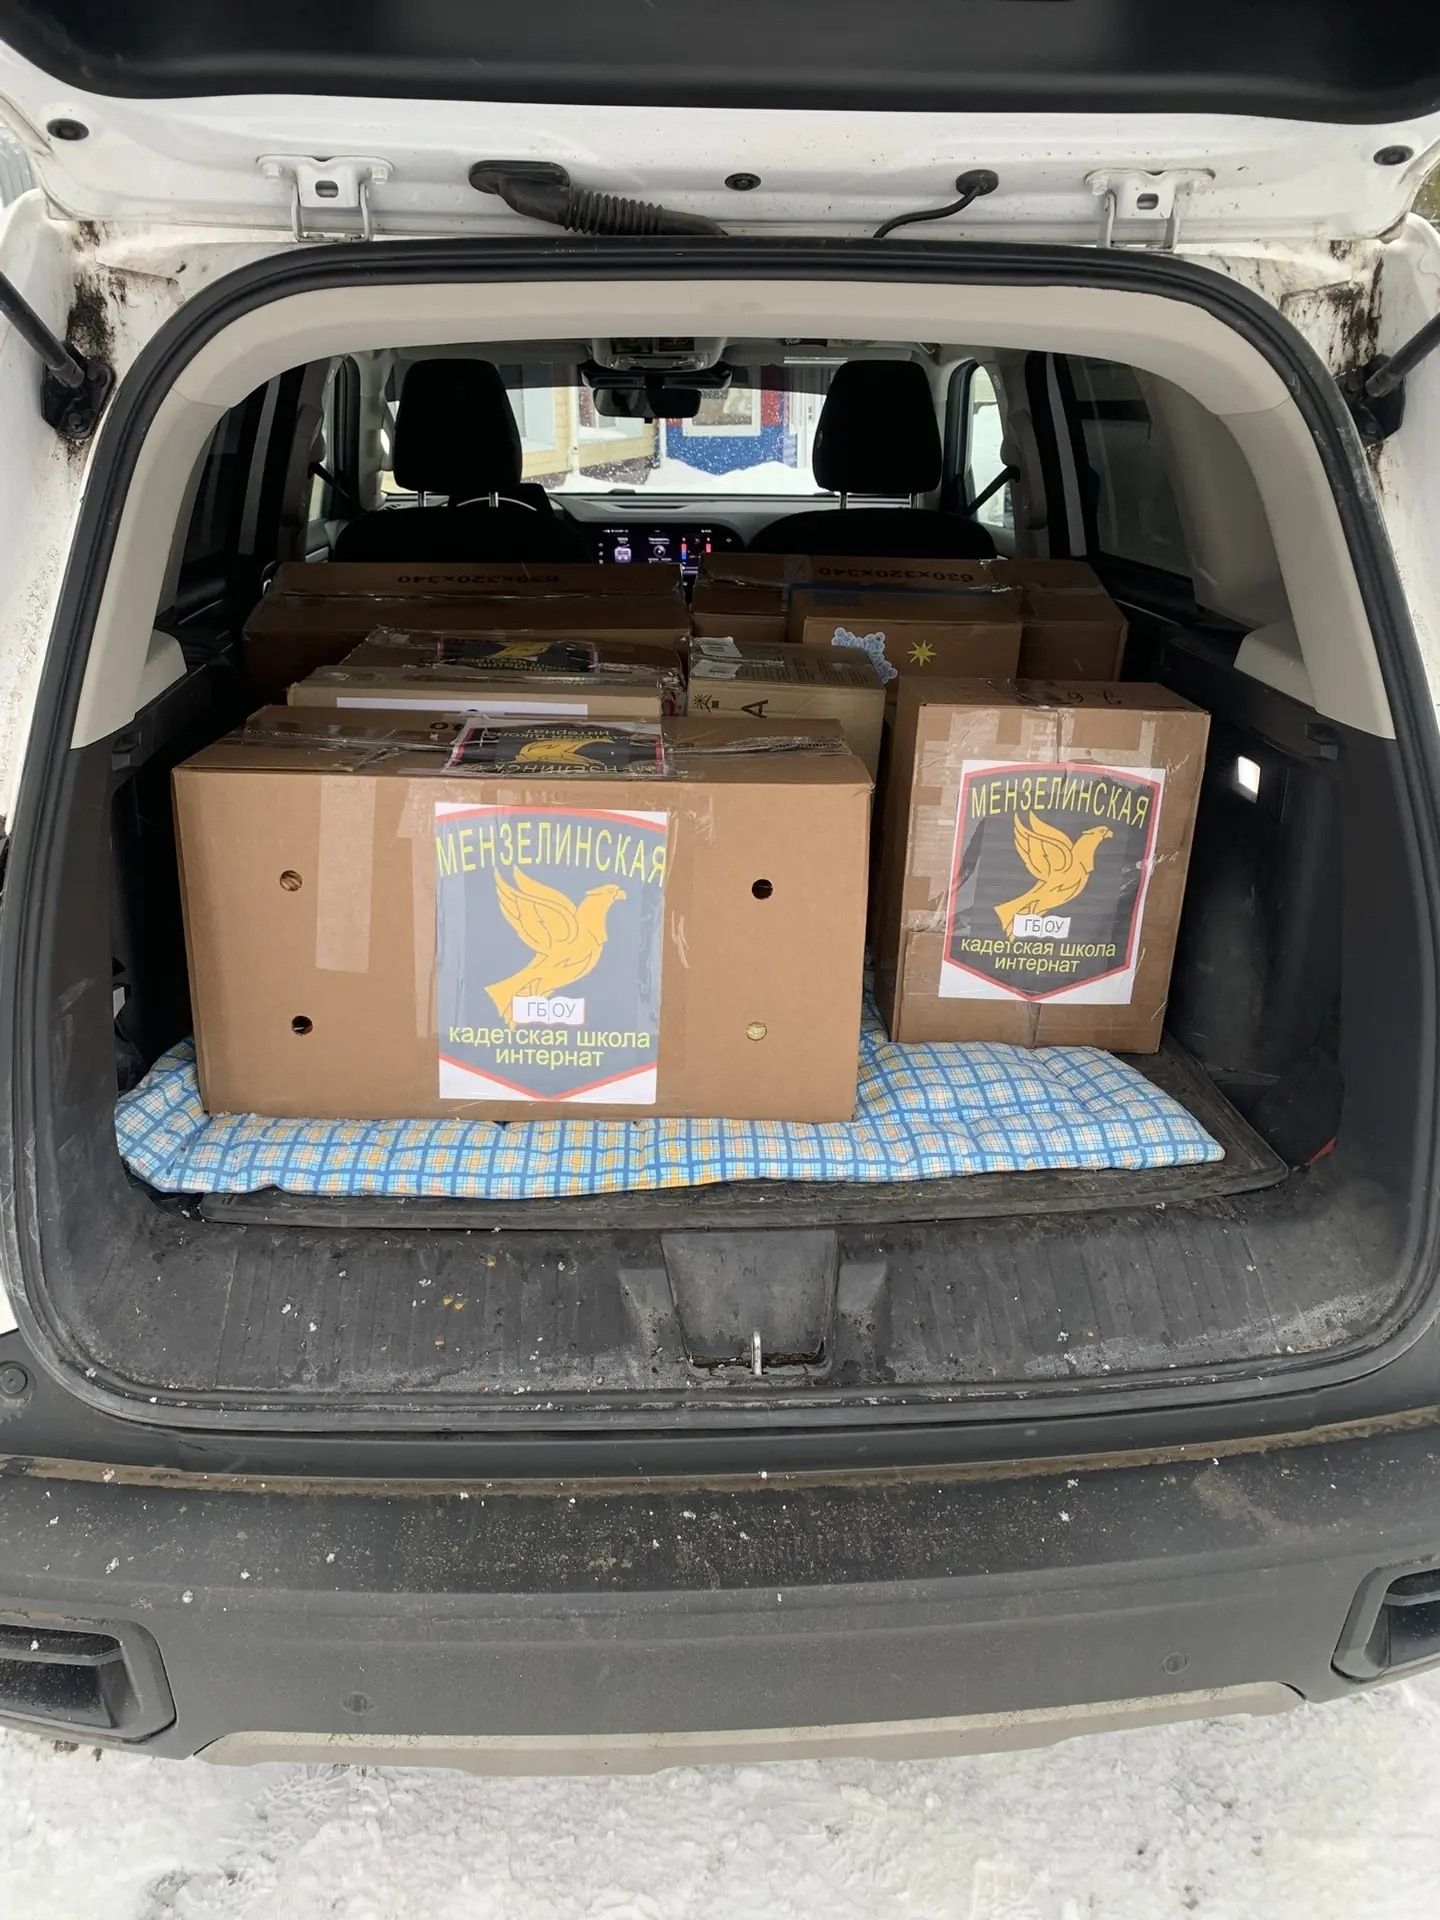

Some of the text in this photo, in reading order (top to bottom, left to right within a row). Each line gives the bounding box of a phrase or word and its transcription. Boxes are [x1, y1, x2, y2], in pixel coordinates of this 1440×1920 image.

[971, 776, 1150, 829] МЕНЗЕЛИНСКАЯ
[435, 821, 667, 888] МЕНЗЕЛИНСКАЯ
[961, 937, 1117, 958] кадетская школа
[994, 956, 1080, 975] интернат
[449, 1026, 651, 1048] кадетская школа
[495, 1047, 604, 1070] интернат
